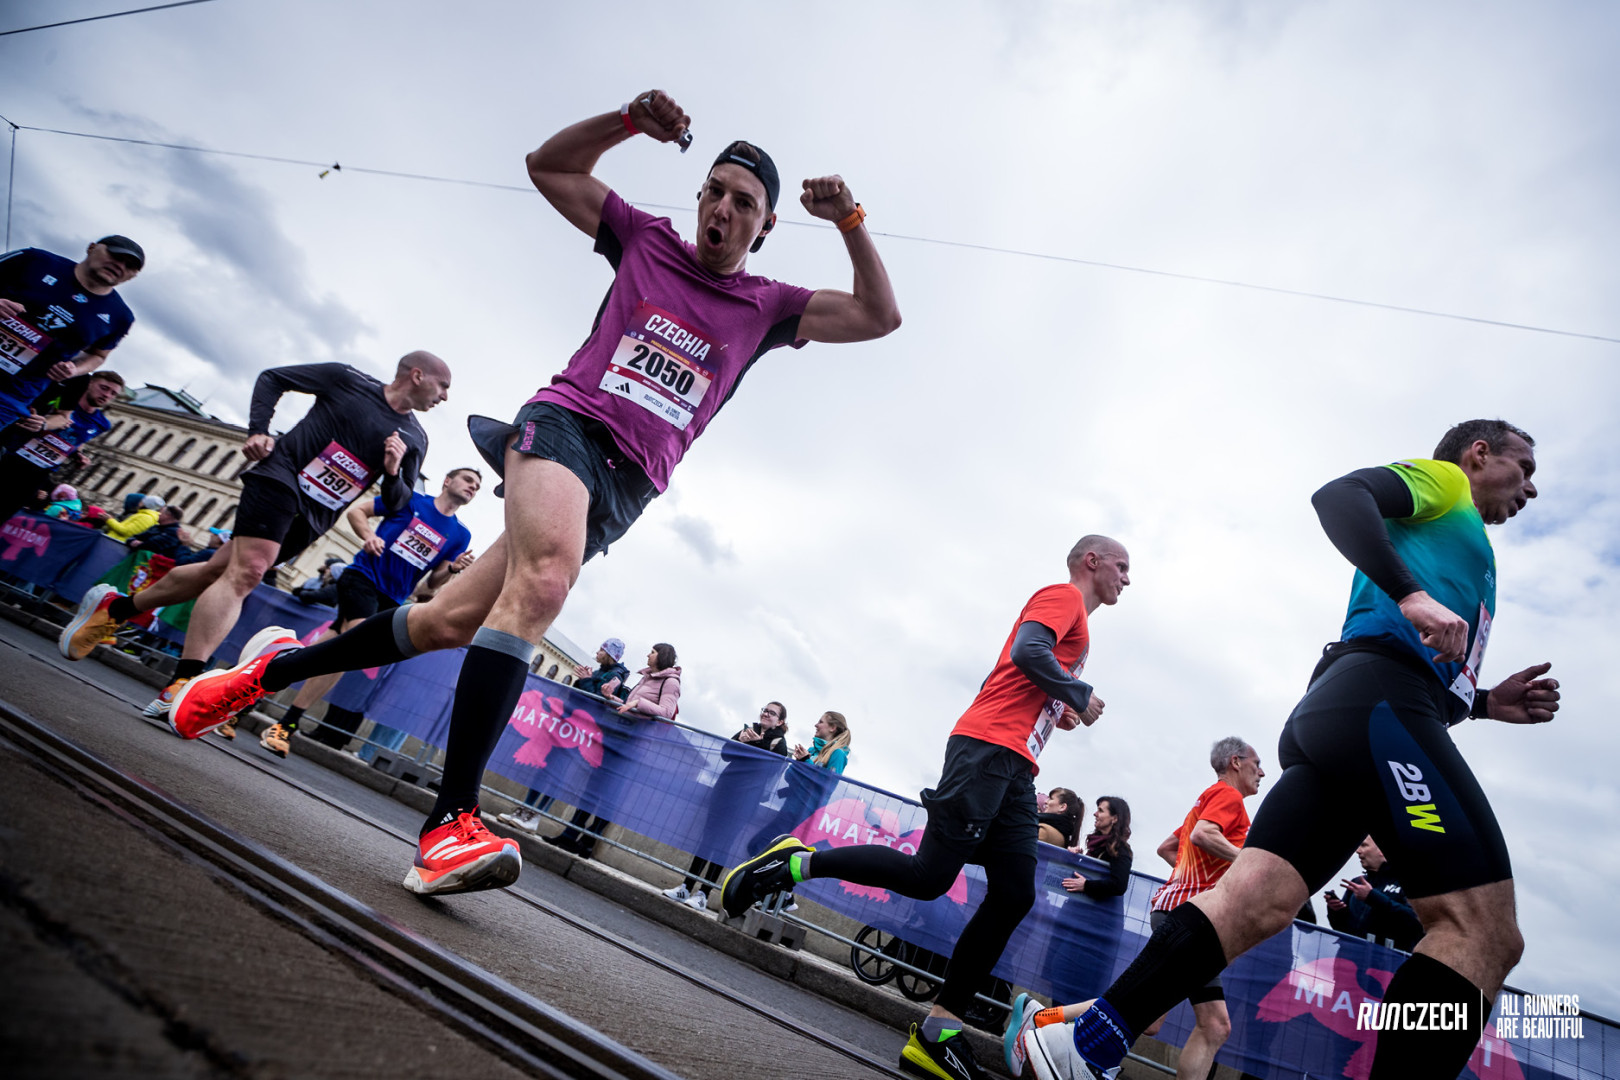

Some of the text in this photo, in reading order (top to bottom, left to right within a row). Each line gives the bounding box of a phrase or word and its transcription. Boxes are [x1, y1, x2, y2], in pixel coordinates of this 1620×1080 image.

[0, 316, 43, 344] ZECHIA
[644, 314, 711, 361] CZECHIA
[627, 344, 695, 396] 2050
[316, 465, 353, 495] 7597
[331, 451, 369, 481] CZECHIA
[2, 524, 49, 547] MATTONI
[405, 535, 432, 557] 2288
[512, 705, 595, 748] MATTONI
[1387, 760, 1446, 834] 2BW
[817, 813, 917, 856] MATTO
